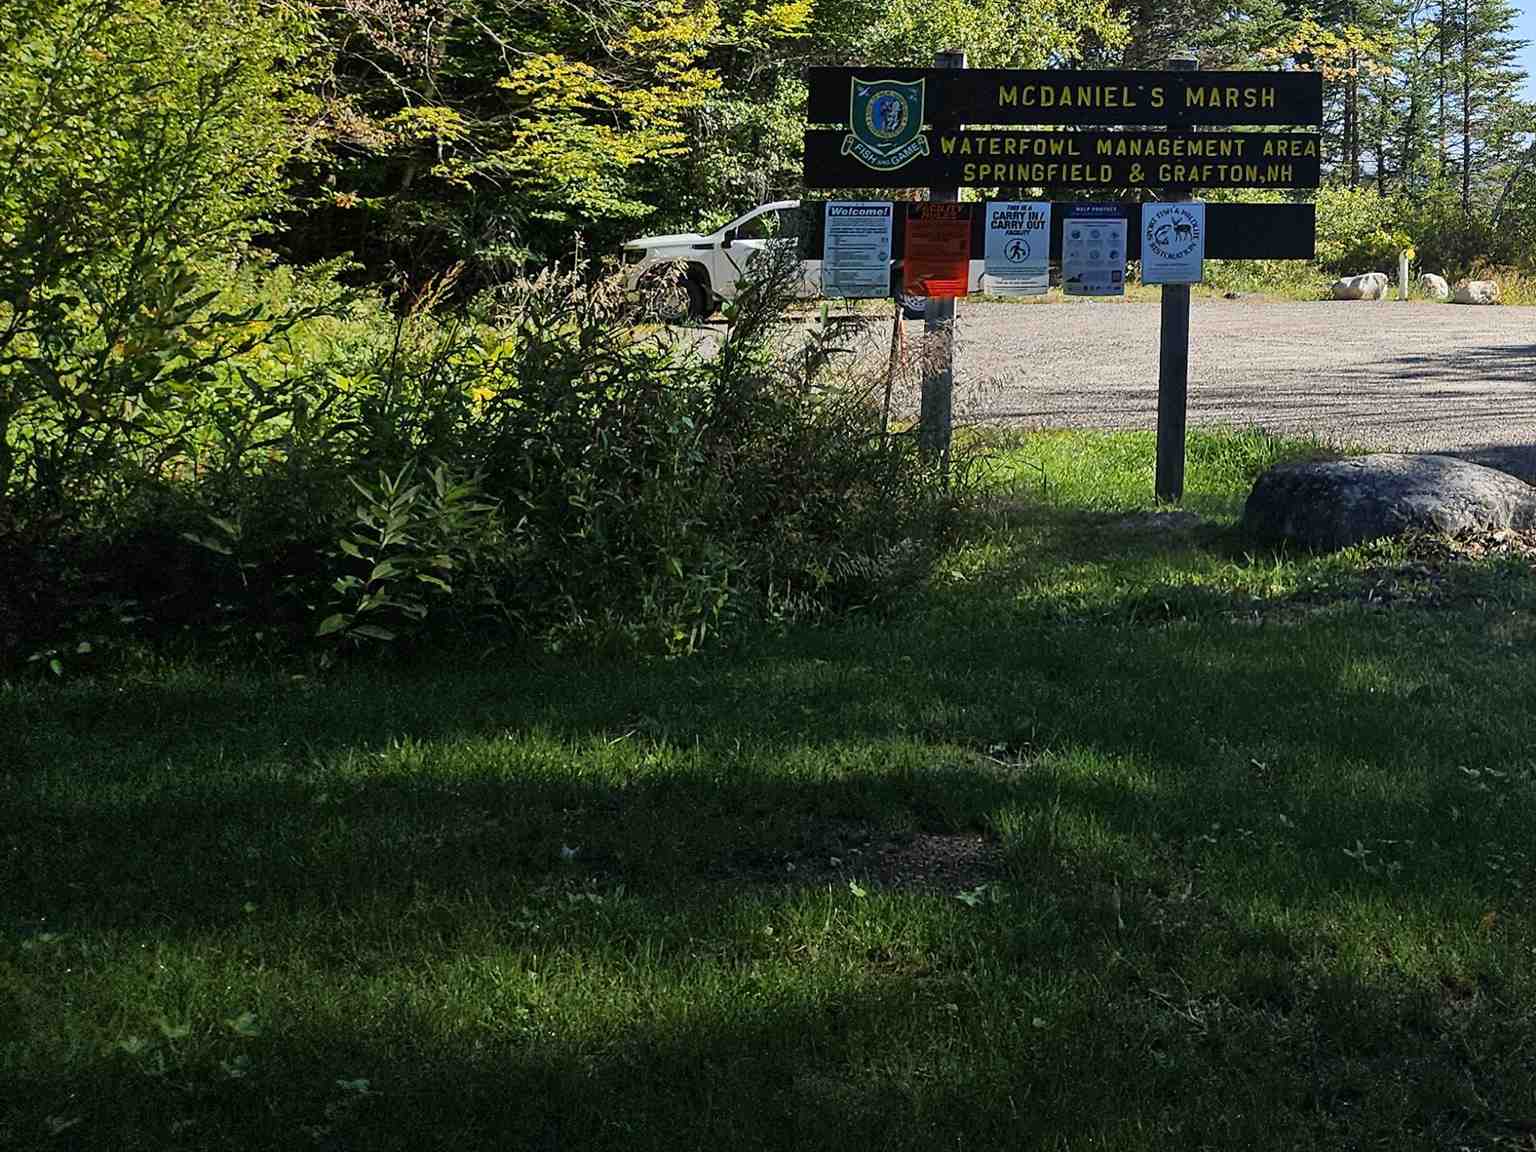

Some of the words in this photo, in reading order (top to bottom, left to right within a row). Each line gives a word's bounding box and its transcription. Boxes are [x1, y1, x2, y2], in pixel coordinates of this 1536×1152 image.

[998, 84, 1165, 108] MCDANIEL'S
[1185, 86, 1276, 108] MARSH
[854, 143, 878, 165] FISH
[890, 142, 920, 165] GAME
[939, 136, 1081, 156] WATERFOWL
[1096, 138, 1246, 156] MANAGEMENT
[1263, 138, 1317, 156] AREA
[962, 162, 1113, 182] SPRINGFIELD
[1128, 163, 1145, 182] &
[831, 207, 888, 216] Welcome!
[993, 211, 1026, 220] CARRY
[991, 220, 1024, 229] CARRY
[1027, 220, 1046, 229] OUT
